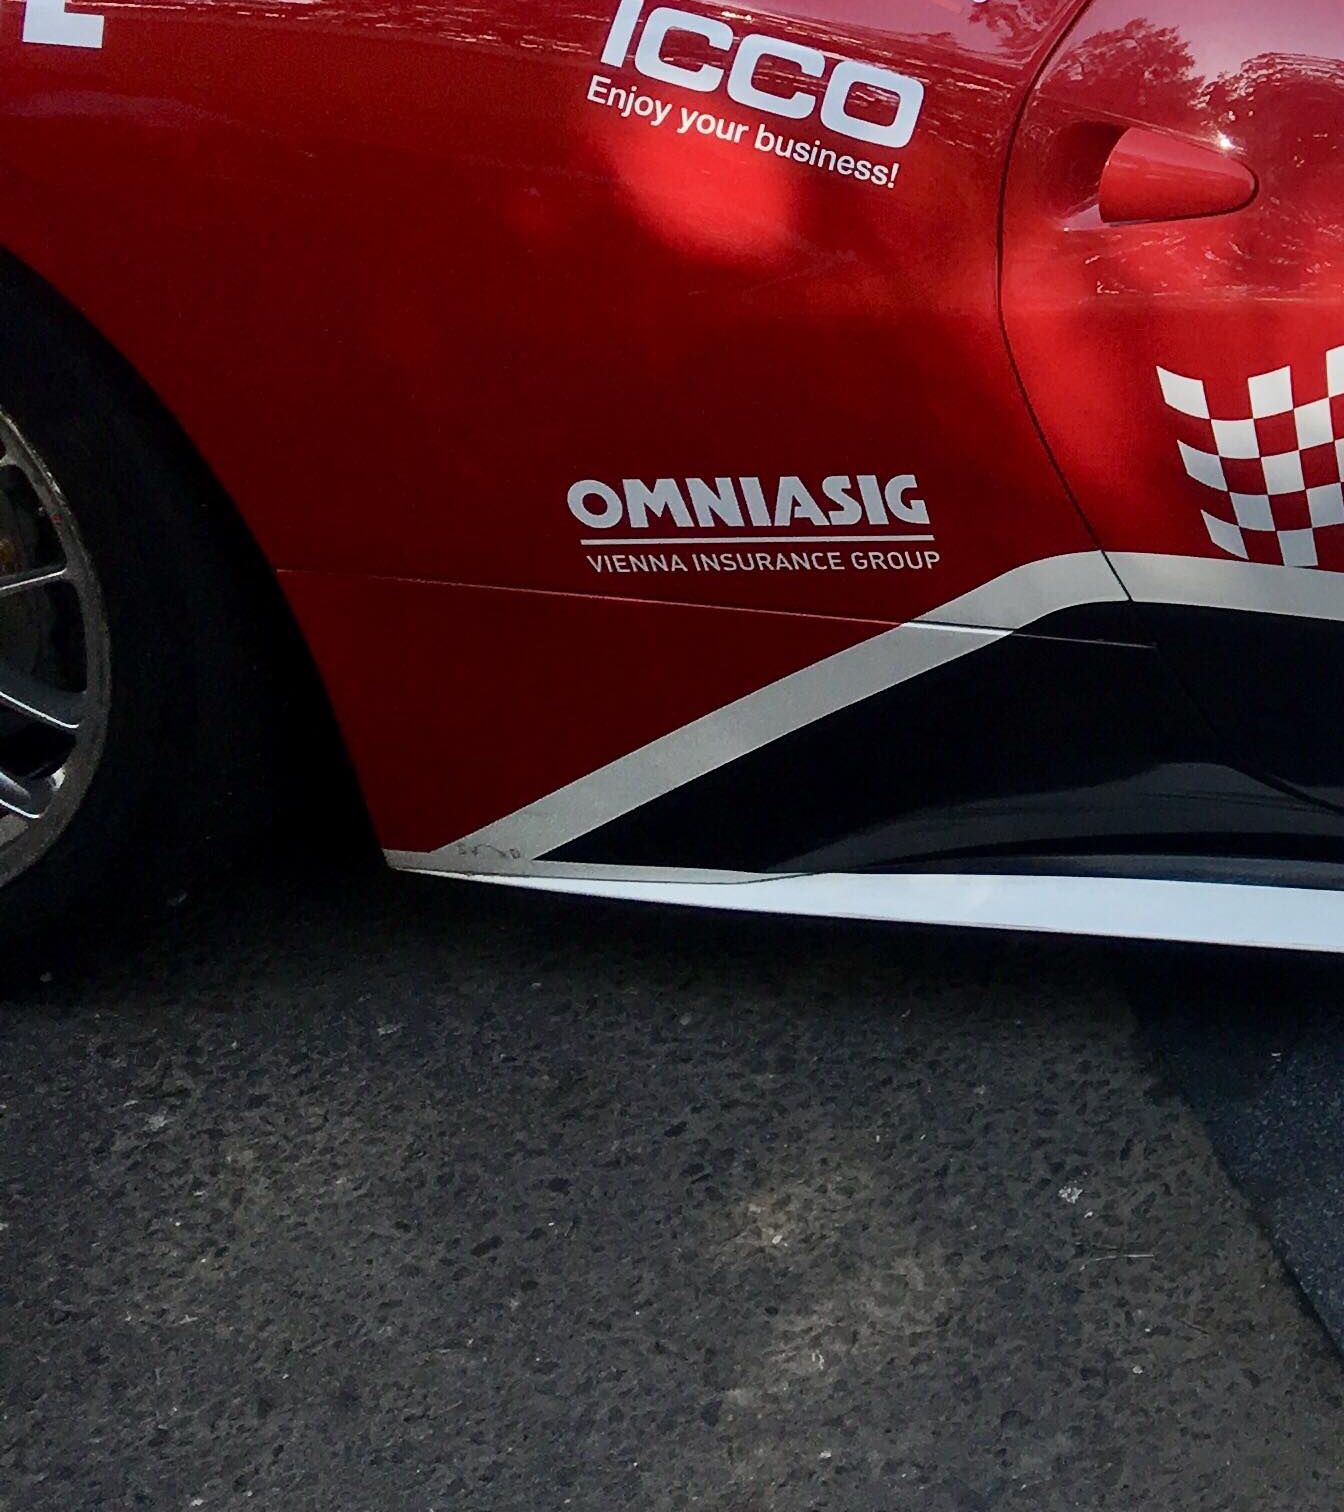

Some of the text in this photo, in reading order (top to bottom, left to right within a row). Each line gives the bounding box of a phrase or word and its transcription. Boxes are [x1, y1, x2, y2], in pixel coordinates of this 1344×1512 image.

[586, 75, 900, 189] Enjoy your business!
[567, 475, 931, 529] OMNIASIG
[587, 550, 942, 574] VIENNA INSURANCE GROUP
